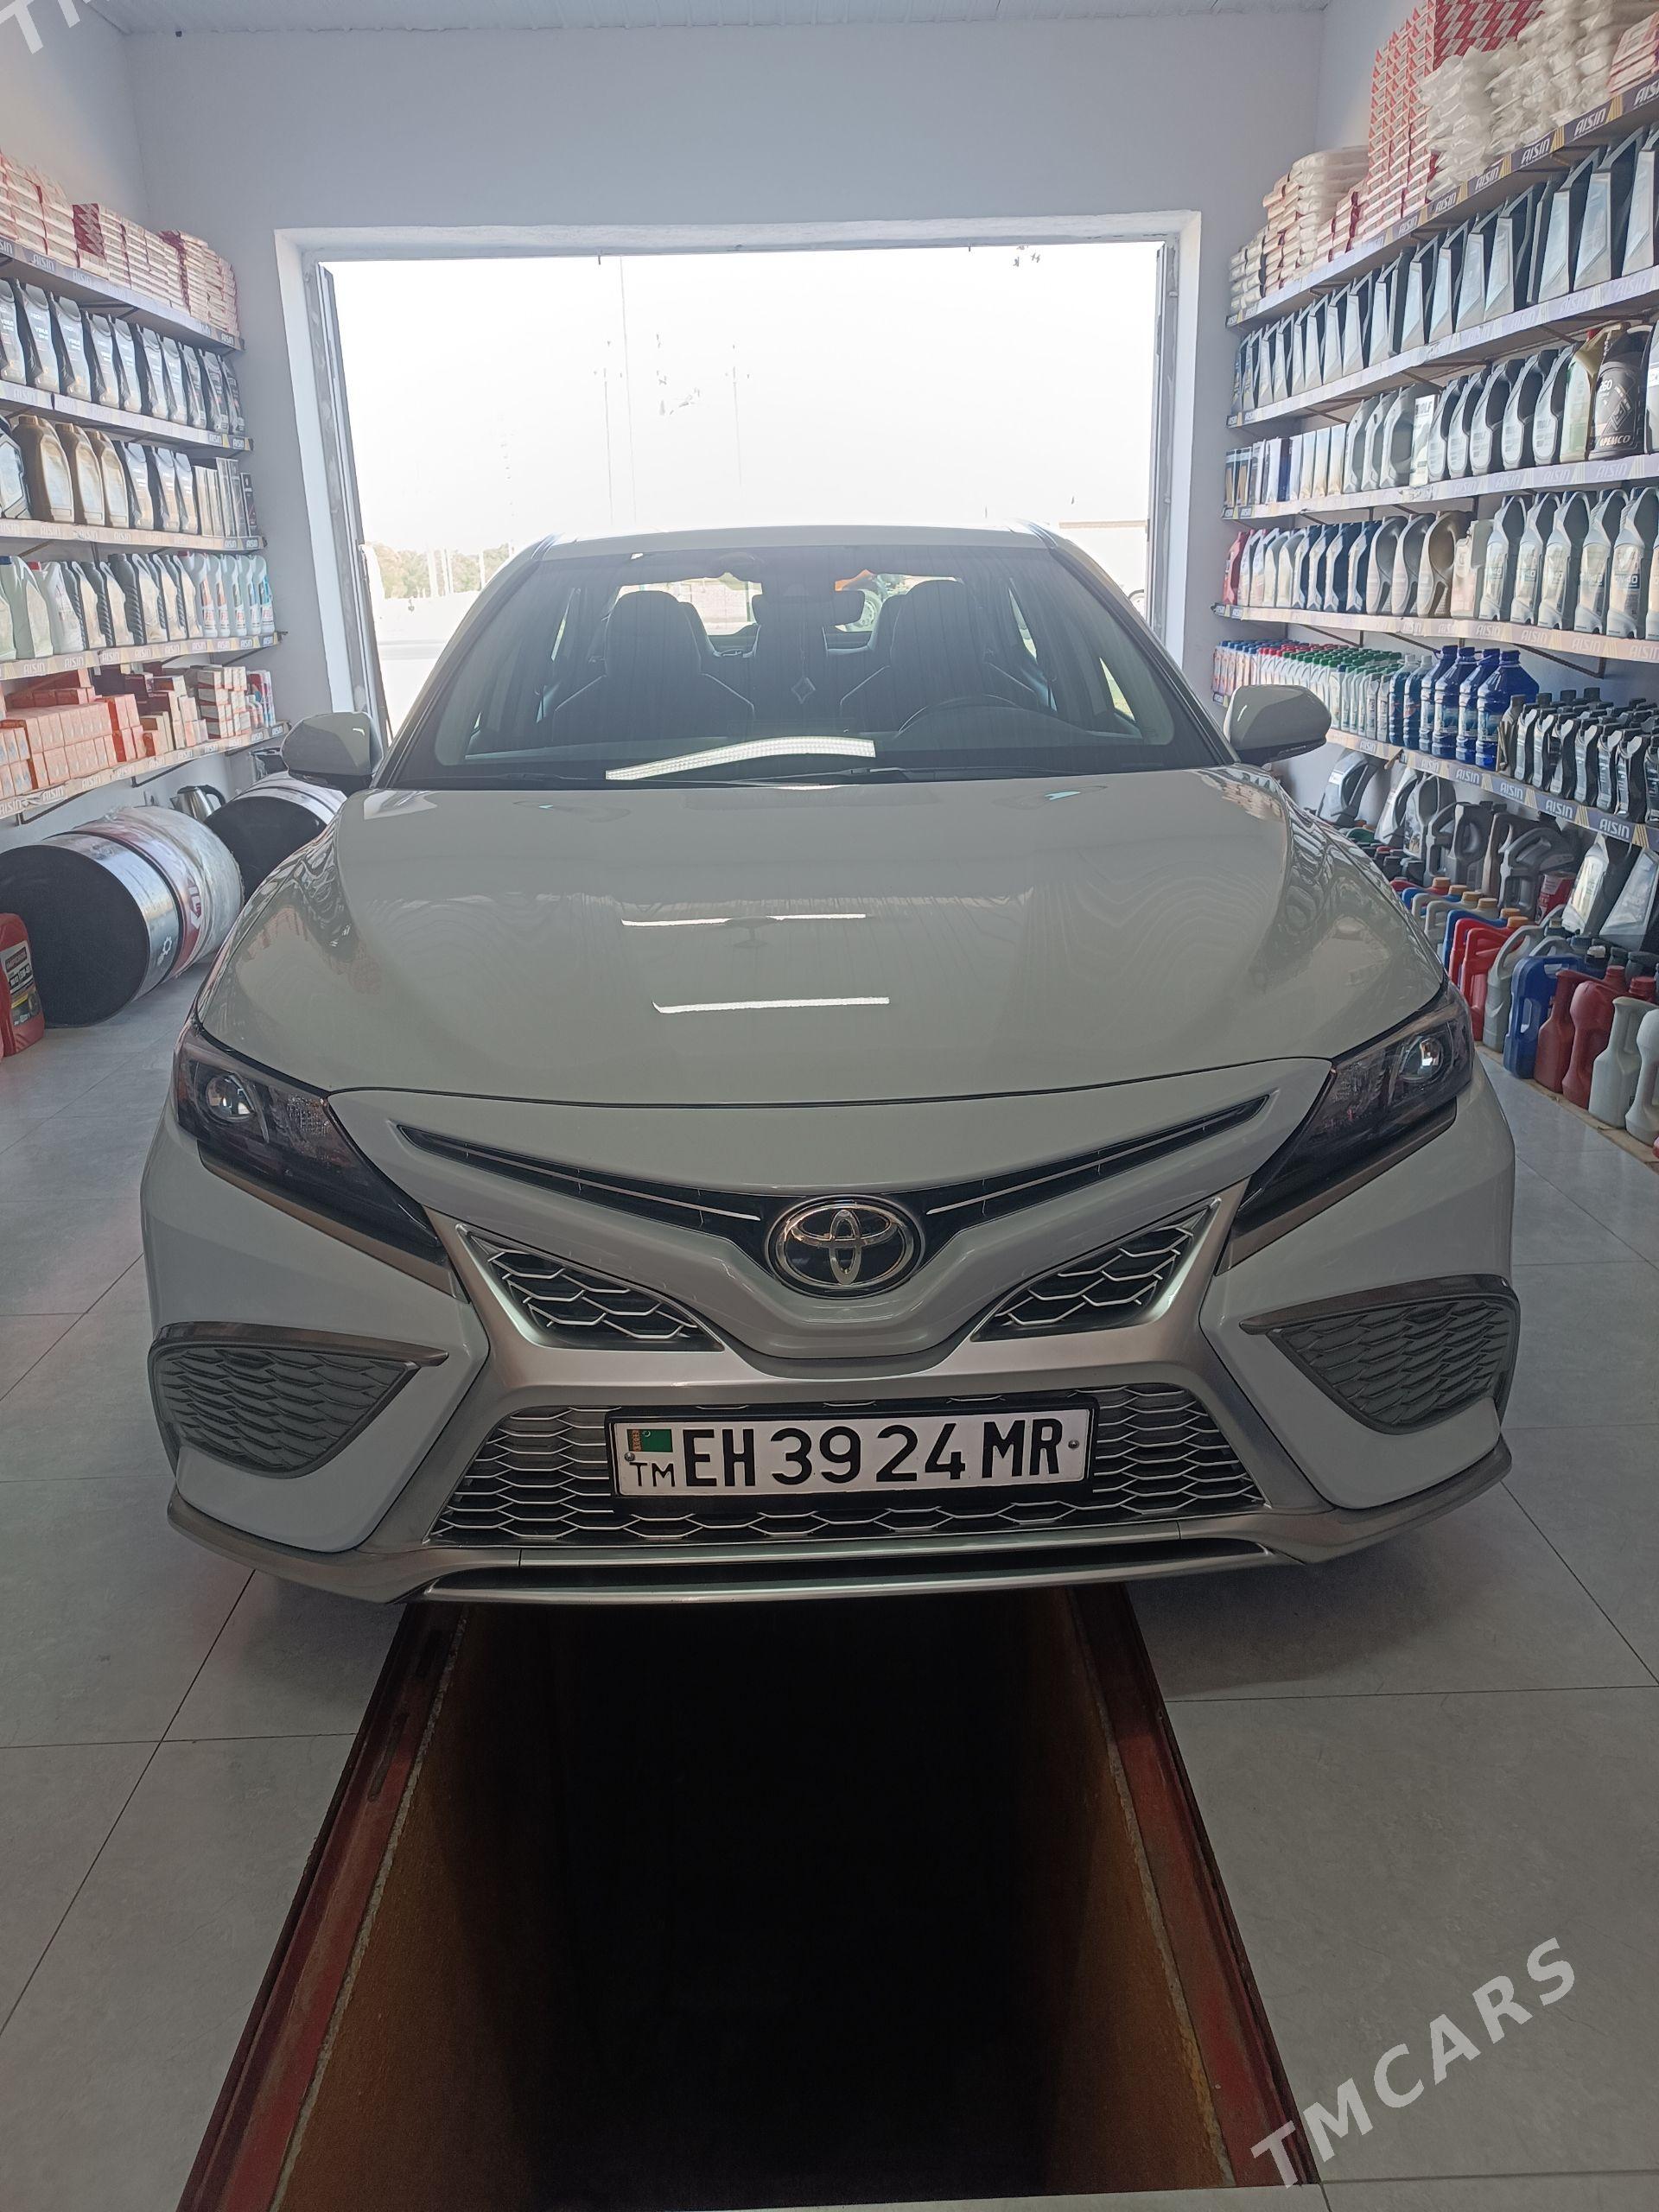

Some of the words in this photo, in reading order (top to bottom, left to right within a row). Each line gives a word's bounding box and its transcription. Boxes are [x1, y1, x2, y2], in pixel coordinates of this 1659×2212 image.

[1574, 108, 1606, 136] AISIN
[1522, 138, 1549, 164] AISIN
[1475, 167, 1499, 190] AISIN
[1435, 192, 1457, 212] AISIN
[1399, 215, 1418, 236] AISIN
[33, 254, 55, 271] AISIN
[73, 270, 91, 284] AISIN
[1617, 276, 1648, 296] AISIN
[1560, 295, 1588, 314] AISIN
[1512, 311, 1536, 329] AISIN
[1543, 469, 1570, 484] AISIN
[1598, 462, 1628, 479] AISIN
[1496, 474, 1521, 489] AISIN
[40, 524, 61, 537] AISIN
[1477, 624, 1500, 636] AISIN
[1522, 630, 1548, 644] AISIN
[165, 644, 180, 654] AISIN
[1572, 638, 1600, 652] AISIN
[102, 651, 119, 663] AISIN
[134, 649, 151, 658] AISIN
[24, 663, 46, 676] AISIN
[65, 657, 84, 669] AISIN
[117, 765, 135, 778] AISIN
[1421, 760, 1439, 772] AISIN
[82, 775, 101, 789] AISIN
[1456, 769, 1479, 784] AISIN
[43, 785, 64, 800] AISIN
[1500, 782, 1523, 800] AISIN
[1546, 799, 1573, 819] AISIN
[1600, 819, 1630, 838] AISIN
[632, 1461, 676, 1487] TM
